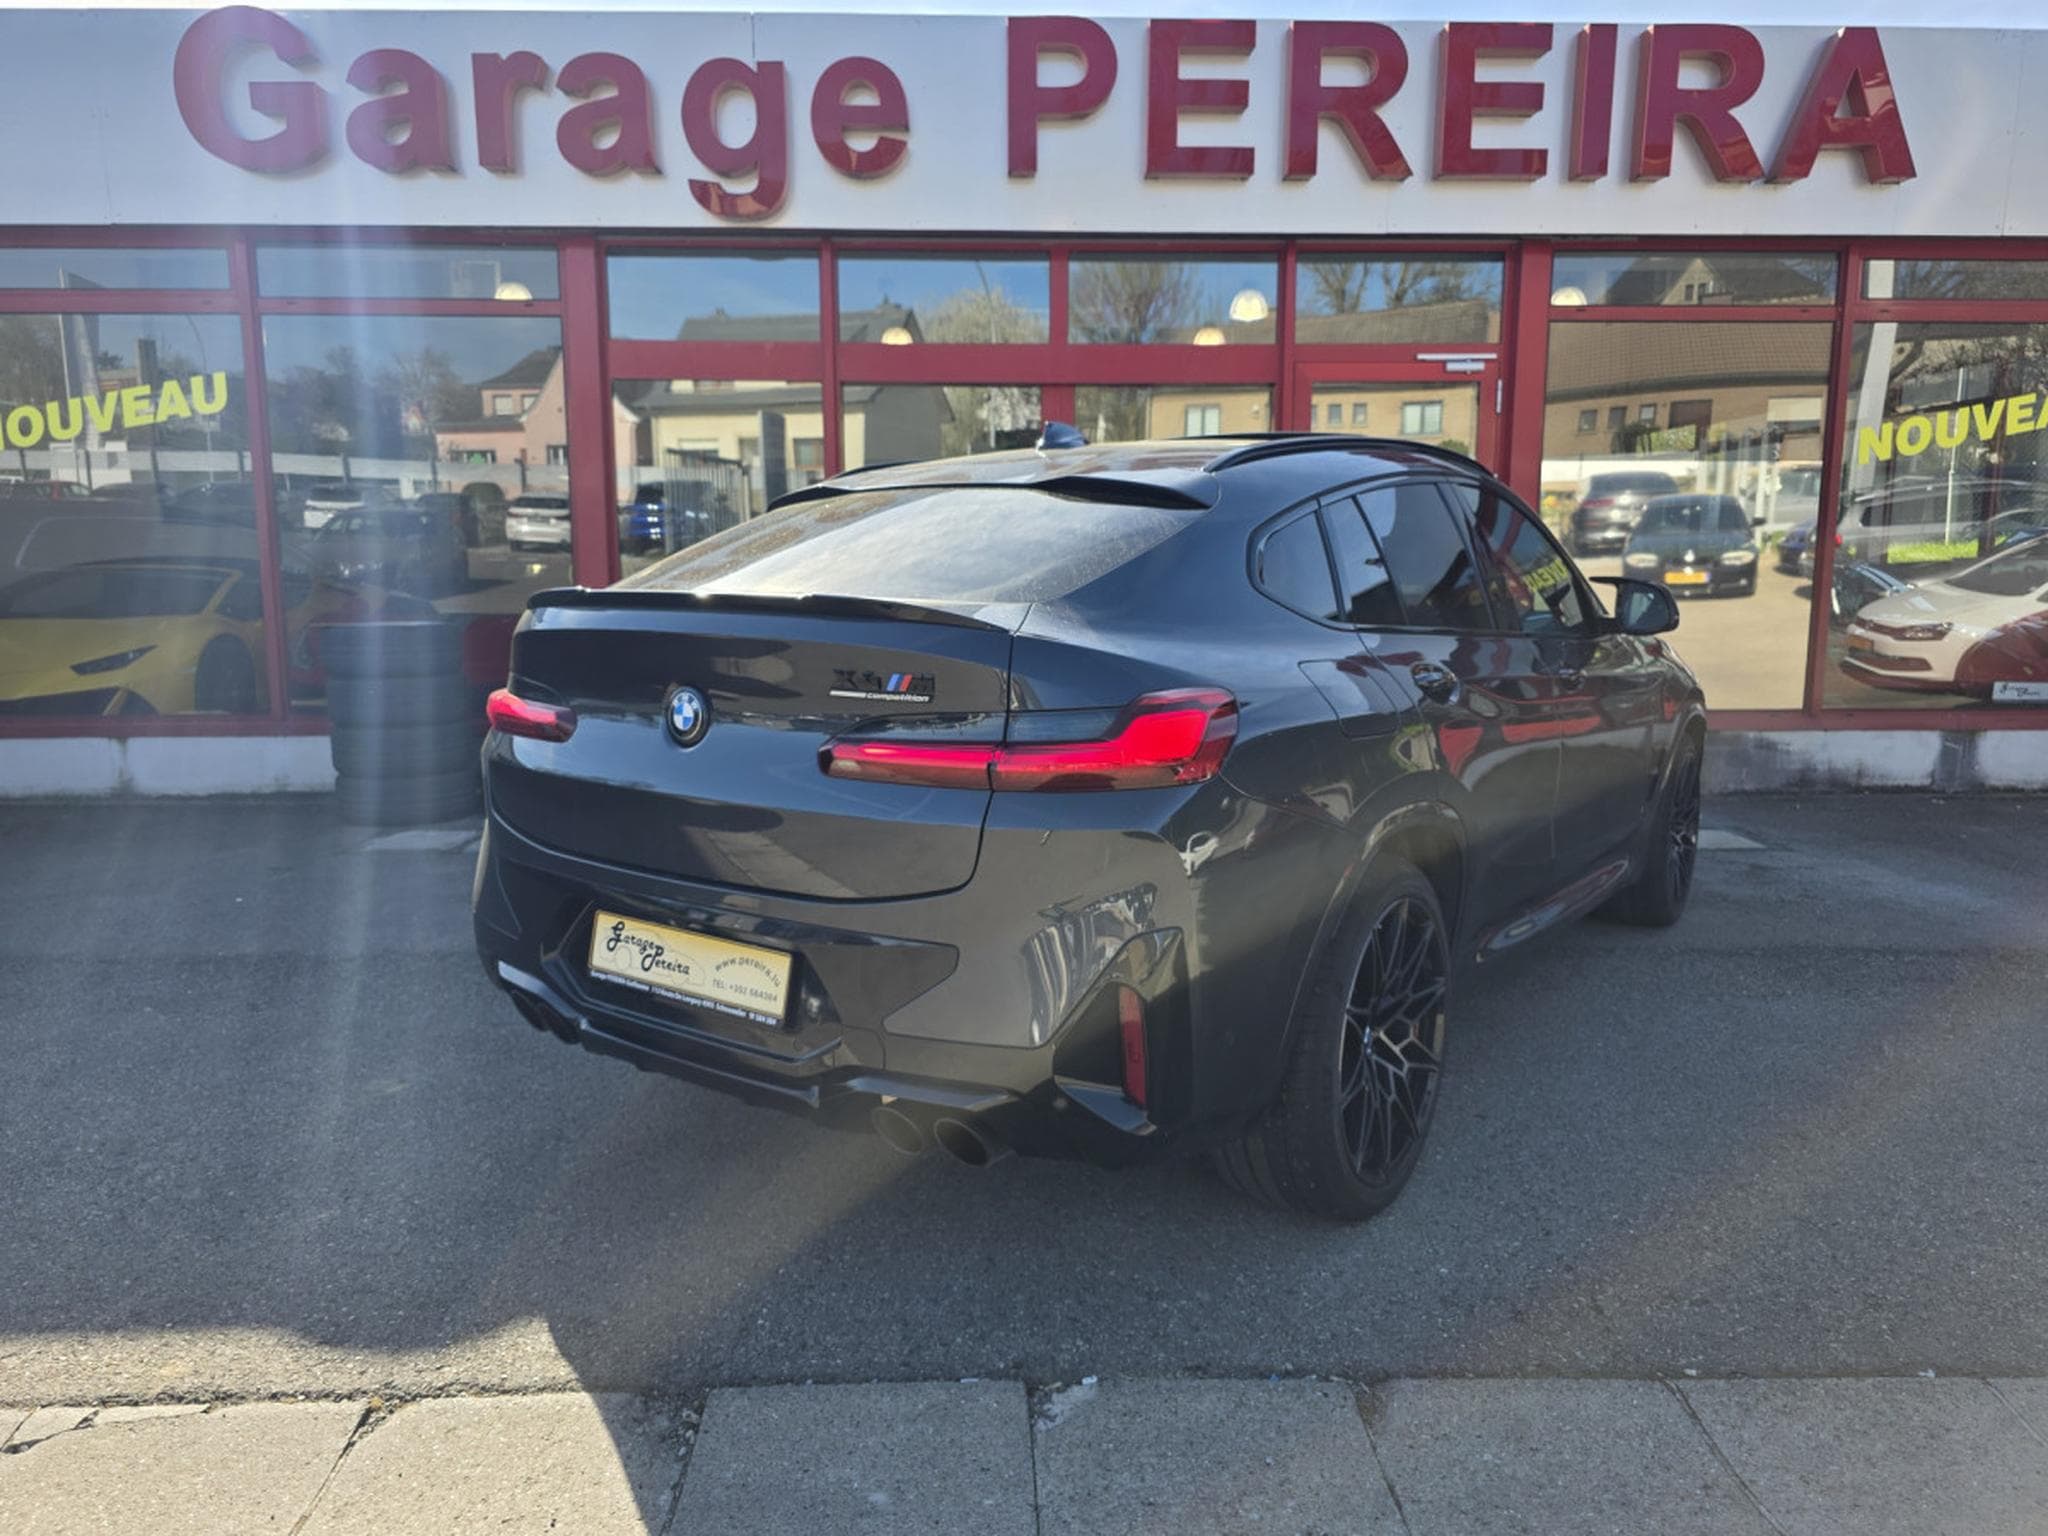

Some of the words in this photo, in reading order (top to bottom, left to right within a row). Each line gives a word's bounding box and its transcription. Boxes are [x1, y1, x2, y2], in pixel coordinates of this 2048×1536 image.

[173, 5, 909, 221] Garage
[1006, 16, 1917, 184] PEREIRA
[0, 371, 228, 451] OUVEAU
[606, 921, 657, 956] Garage
[641, 945, 690, 974] Pereira
[715, 956, 782, 988] www.pereira.lu
